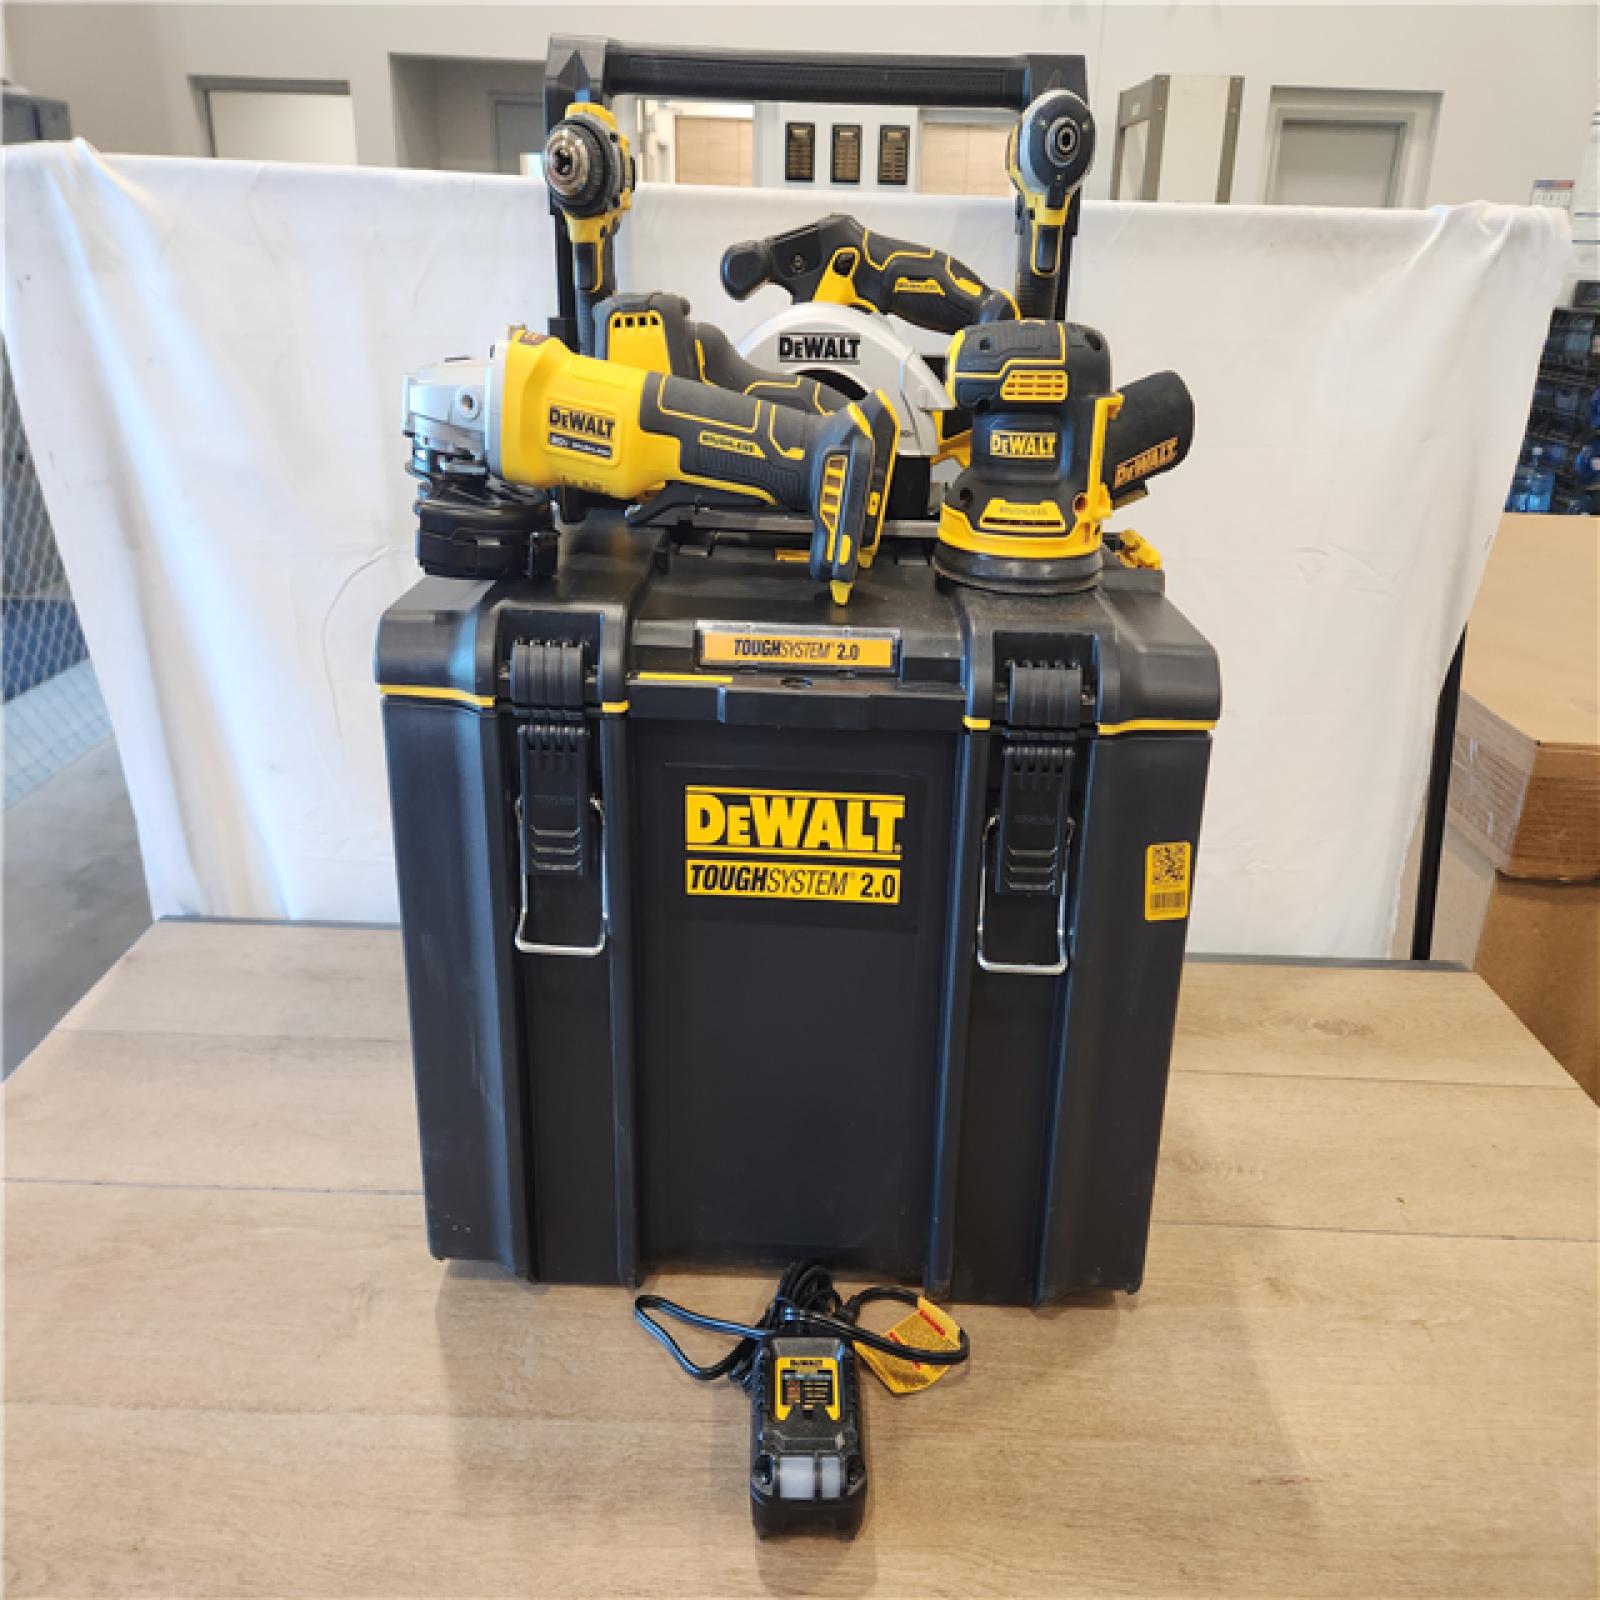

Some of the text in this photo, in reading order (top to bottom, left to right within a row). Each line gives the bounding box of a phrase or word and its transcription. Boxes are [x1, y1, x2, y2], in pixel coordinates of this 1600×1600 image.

[779, 336, 861, 359] DEWALT
[549, 407, 616, 438] DEWALT
[990, 432, 1057, 456] DEWALT
[1114, 436, 1179, 488] DEWALT
[734, 638, 861, 661] TOUGHSYSTEM 2.0
[686, 793, 905, 854] DEWALT
[690, 863, 897, 900] TOUGHSYSTEM 2.0
